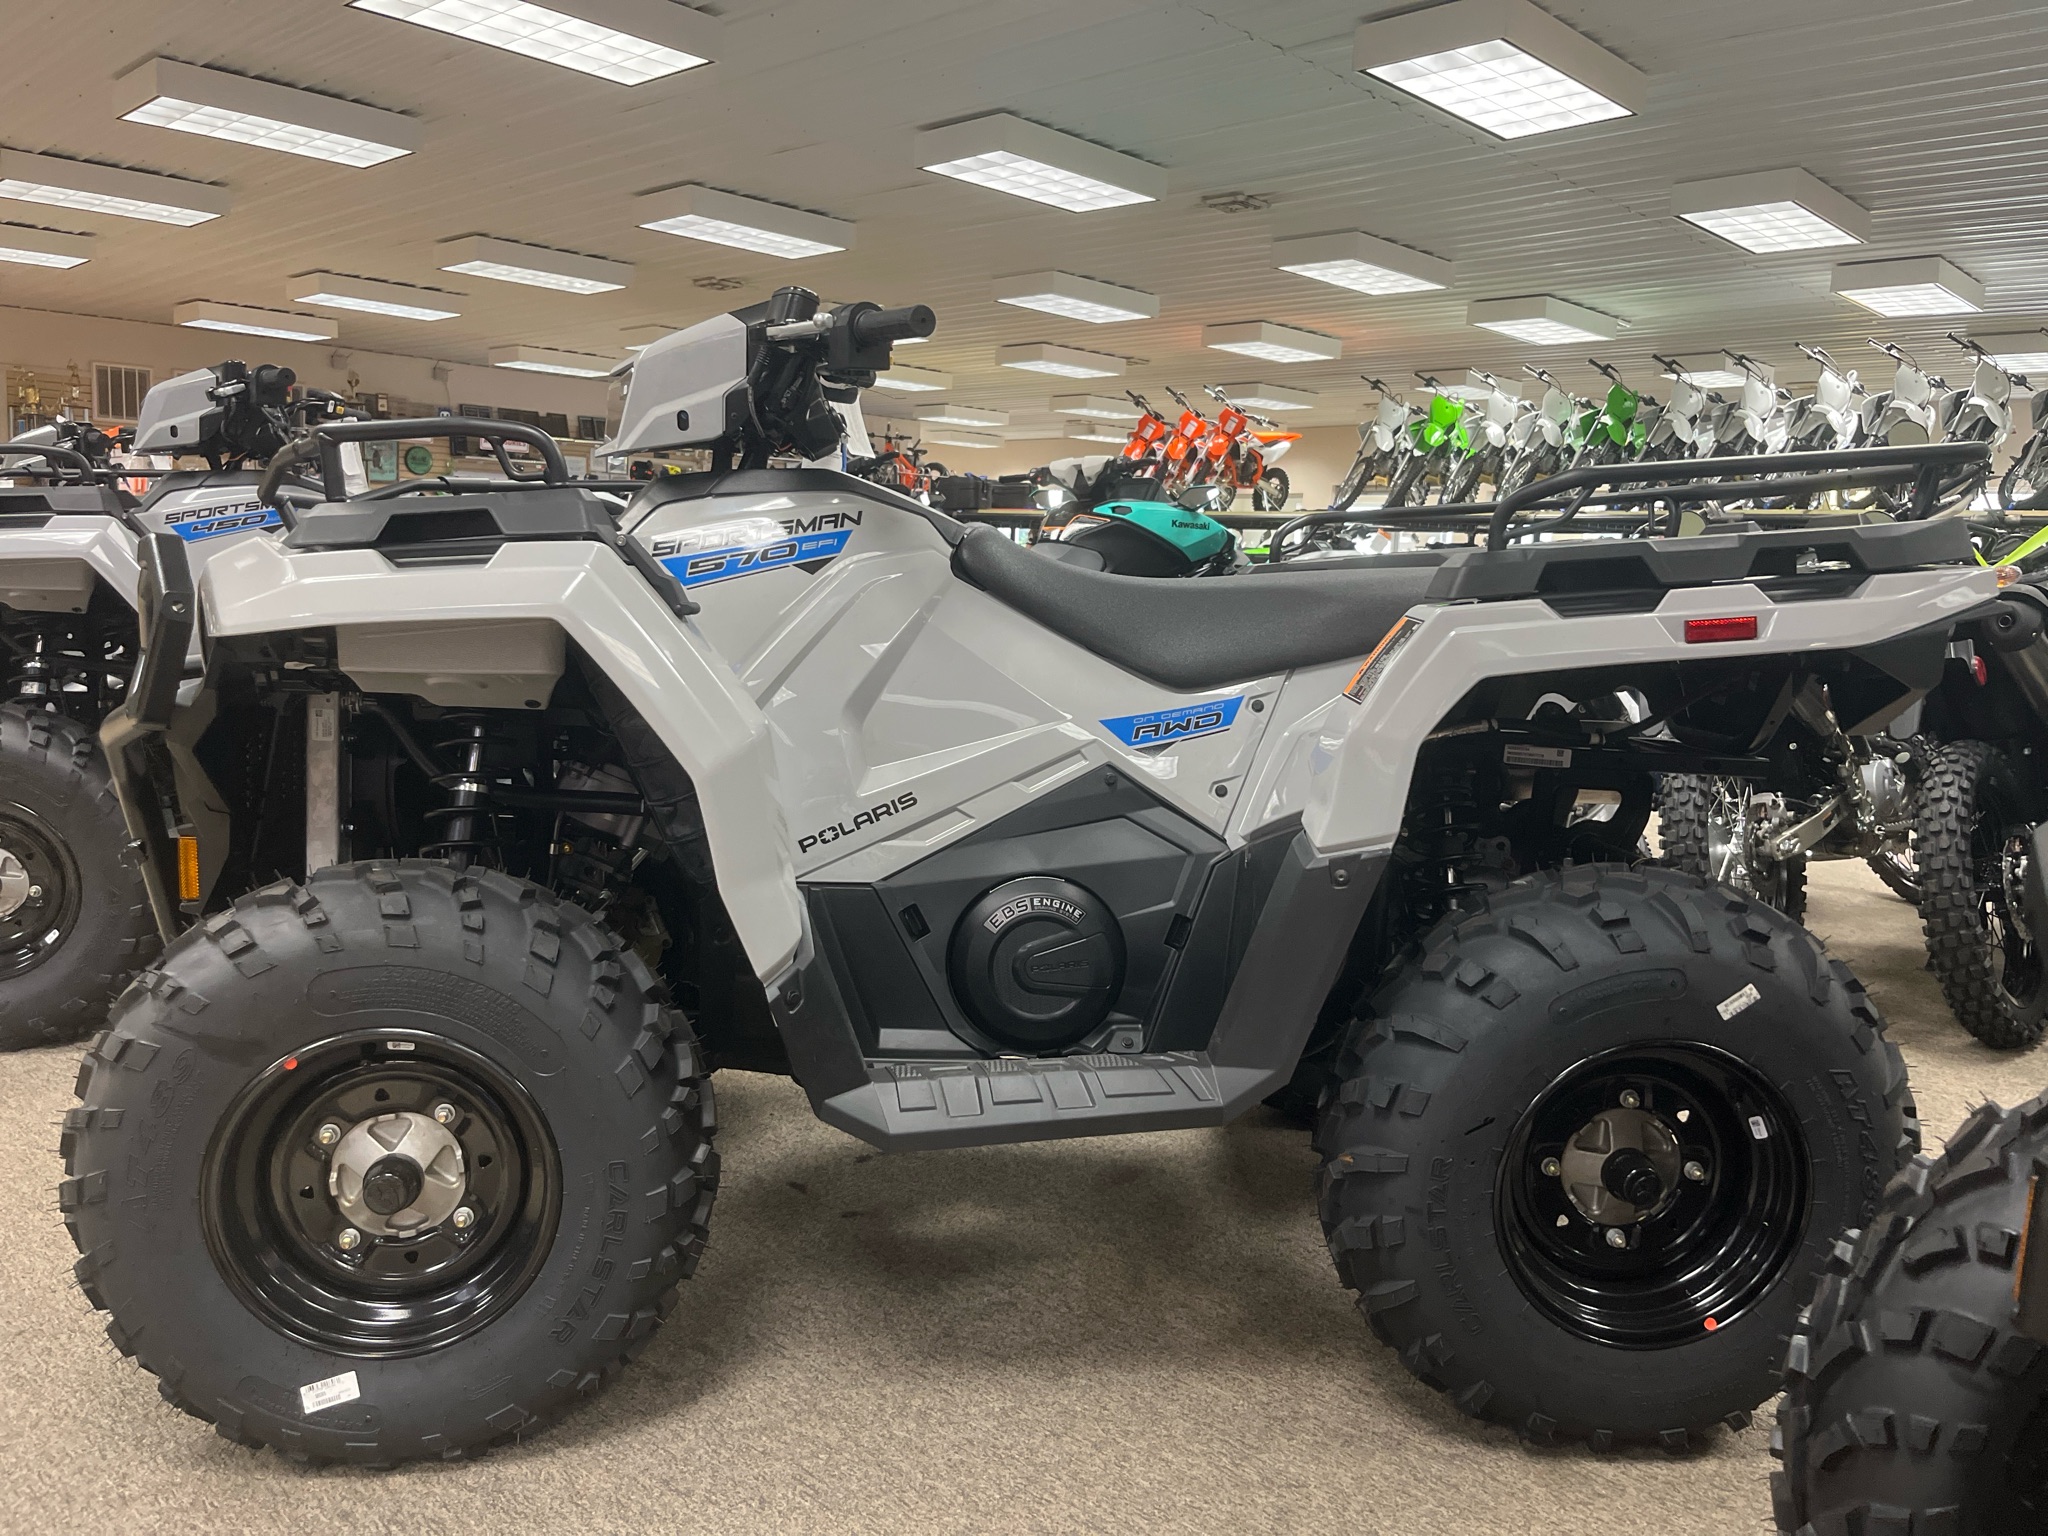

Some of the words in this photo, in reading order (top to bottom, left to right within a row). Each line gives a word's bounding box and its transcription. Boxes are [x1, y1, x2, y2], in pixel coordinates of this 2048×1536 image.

[191, 514, 268, 533] 450
[651, 511, 863, 558] SPORTSMAN
[1171, 519, 1210, 531] Kawasaki
[686, 543, 799, 578] 570
[801, 538, 838, 551] EFI
[1131, 711, 1223, 742] AWD
[1160, 703, 1225, 720] DEMAND
[798, 791, 918, 853] POLARIS
[989, 899, 1029, 929] EBS
[1033, 897, 1083, 919] ENGINE
[1030, 959, 1090, 973] POLARIS
[550, 1160, 629, 1344] CARLSTAR
